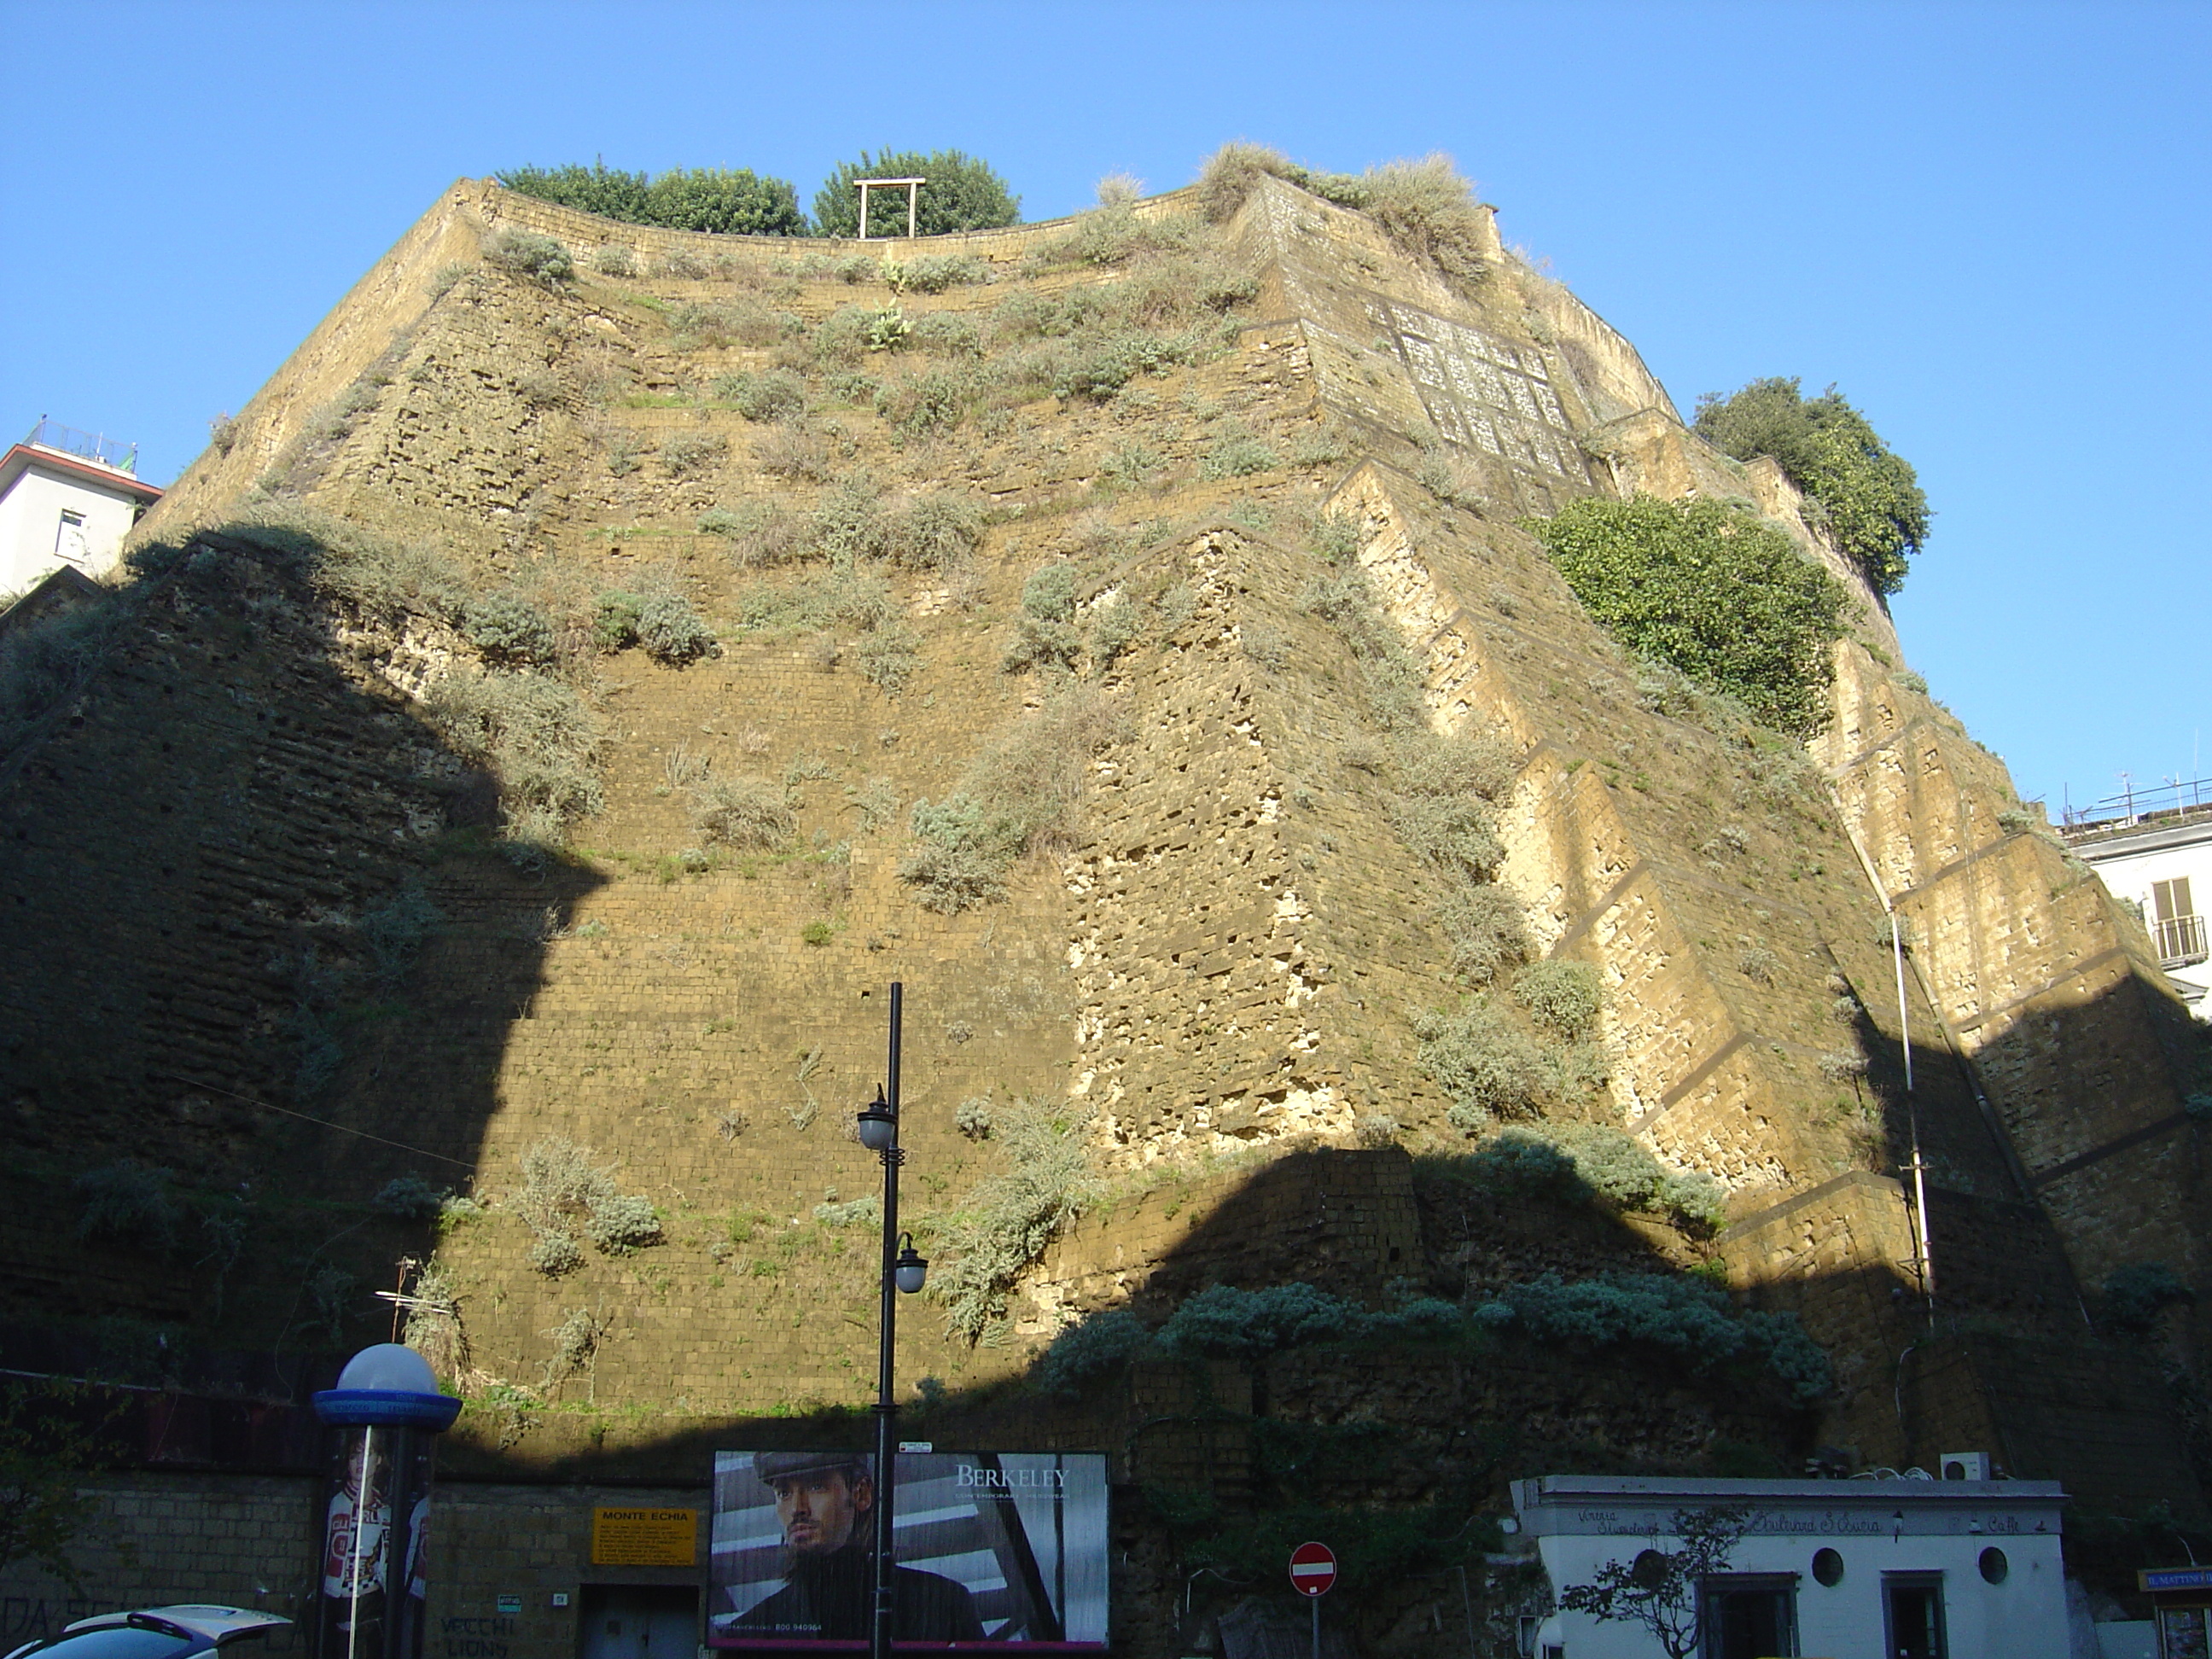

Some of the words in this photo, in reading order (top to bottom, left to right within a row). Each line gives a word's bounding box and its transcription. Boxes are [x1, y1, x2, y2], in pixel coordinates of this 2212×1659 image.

[955, 1464, 1070, 1487] BERKELEY
[602, 1511, 646, 1520] MONTE
[651, 1512, 688, 1521] ECHIA
[2159, 1575, 2204, 1585] MATTINO
[440, 1618, 514, 1636] VECCHI
